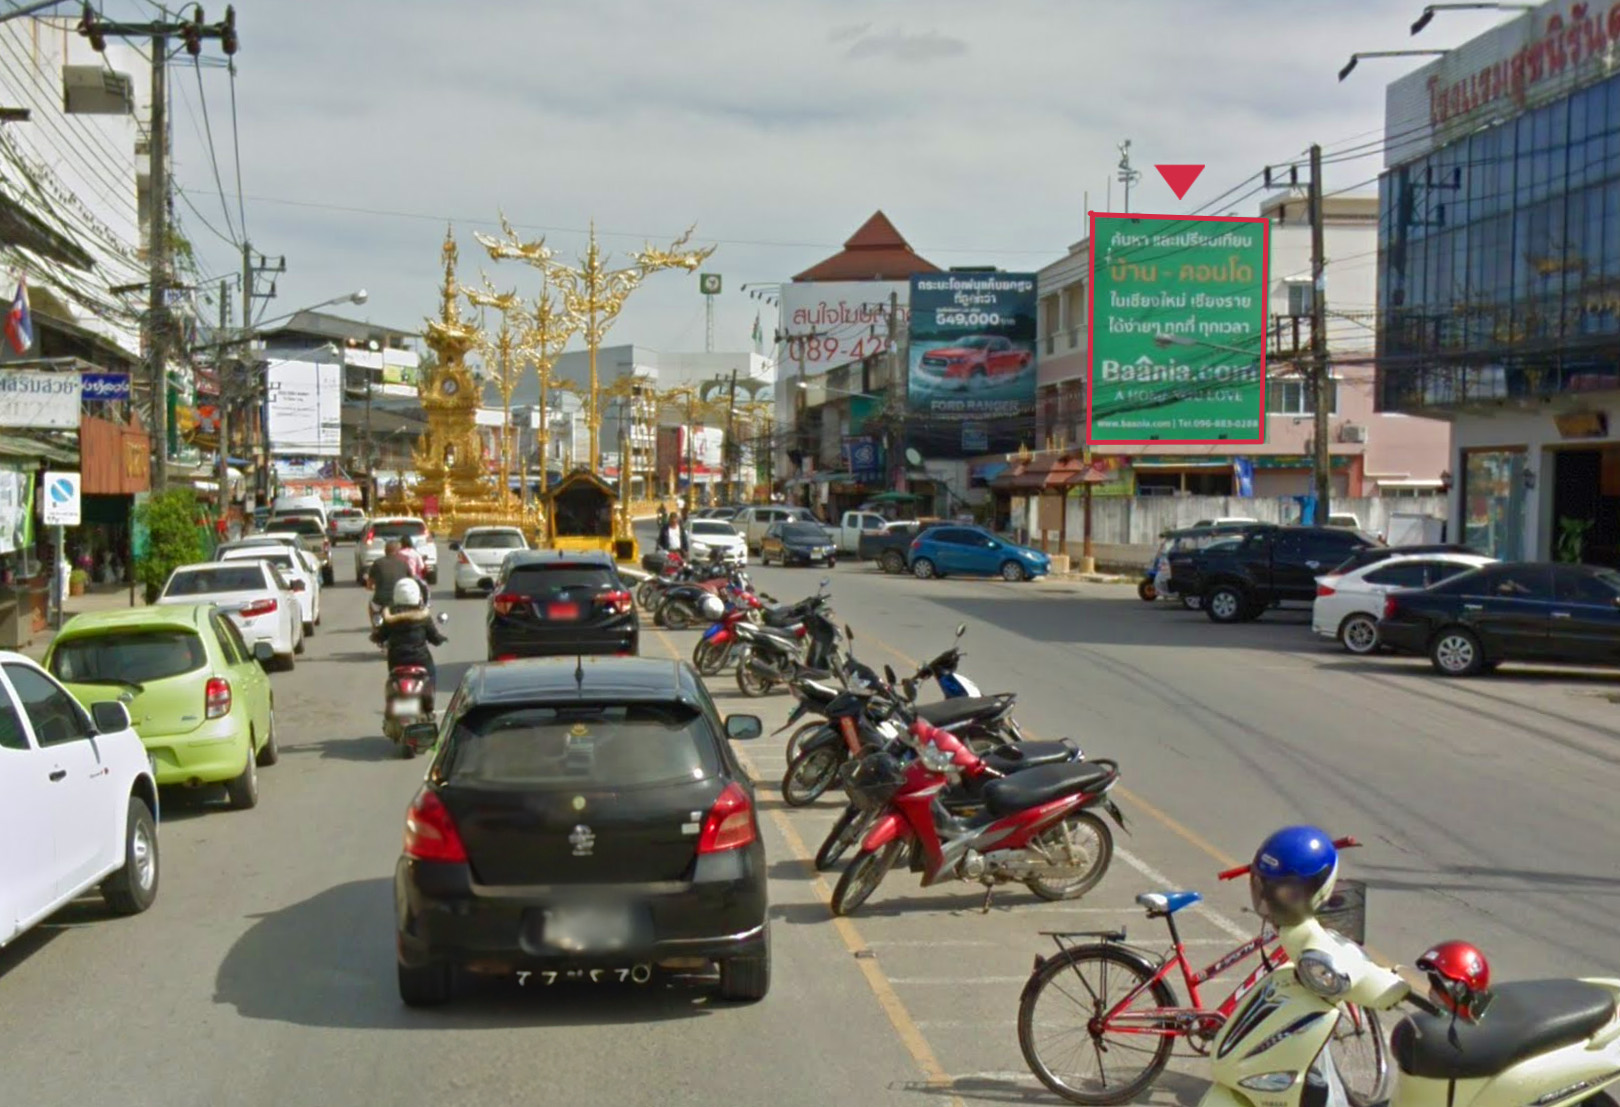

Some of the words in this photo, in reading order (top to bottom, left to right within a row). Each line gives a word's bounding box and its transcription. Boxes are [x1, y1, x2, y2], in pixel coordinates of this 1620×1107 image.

[1111, 231, 1149, 248] ค้นหา
[1153, 231, 1252, 248] และเปรียบเทียบ
[1111, 257, 1158, 281] บ้าน
[1179, 256, 1254, 281] คอนโด
[1110, 290, 1187, 308] ในเชียงใหม่
[1191, 293, 1251, 308] เชียงราย
[1108, 316, 1161, 337] ได้ง่ายๆ
[1200, 321, 1249, 337] ทุกเวลา
